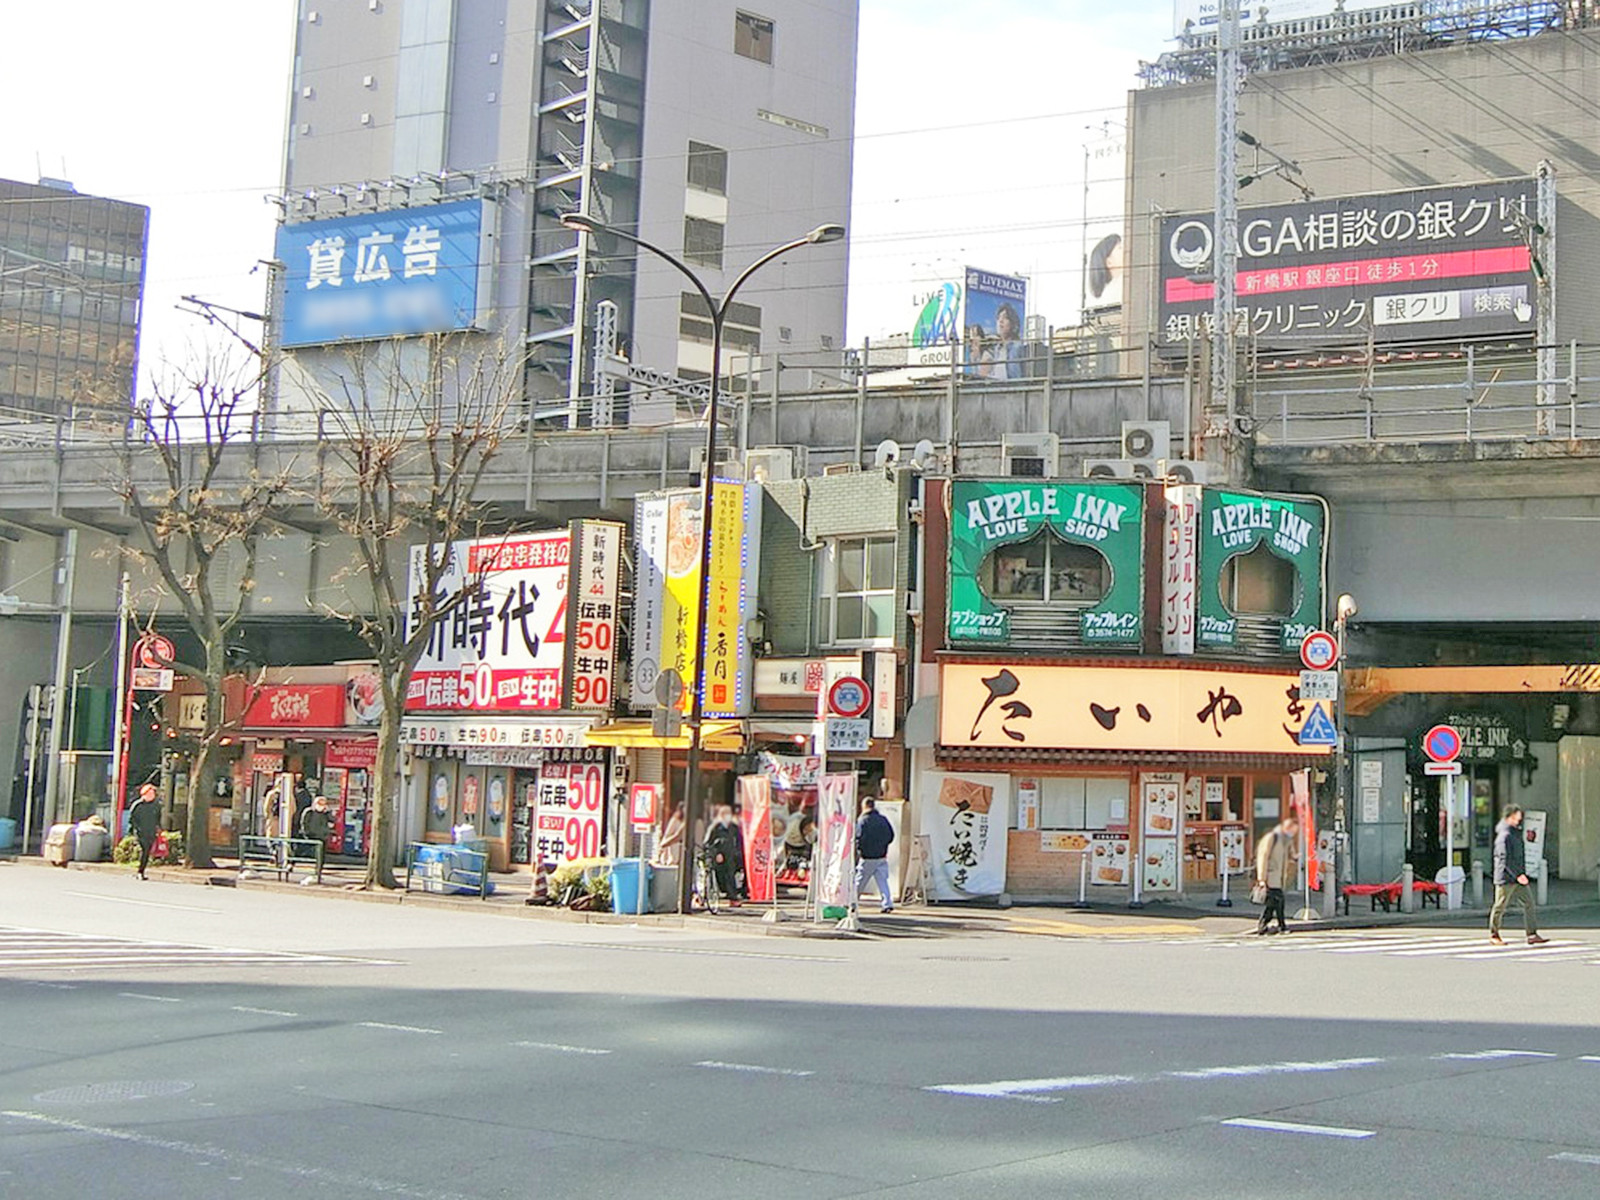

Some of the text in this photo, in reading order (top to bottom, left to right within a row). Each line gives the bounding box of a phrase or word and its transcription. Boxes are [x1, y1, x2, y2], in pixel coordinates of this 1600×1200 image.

[306, 225, 441, 290] 貸広告
[1246, 271, 1299, 291] 新橋駅
[1306, 266, 1359, 286] 銀座口
[1386, 293, 1512, 320] 銀クリ 検索
[920, 351, 953, 364] GROU
[967, 488, 1127, 531] APPLE INN
[984, 518, 1108, 541] LOVE SHOP
[1212, 502, 1313, 548] APPLE INN
[1222, 529, 1302, 555] LOVE SHOP
[581, 602, 612, 620] 伝串
[1084, 611, 1138, 628] アップルイン
[578, 621, 611, 650] 50
[578, 657, 609, 674] 生中
[641, 668, 654, 683] 33
[519, 675, 557, 706] 生中
[574, 676, 609, 704] 90
[970, 668, 1305, 746] たいやき
[832, 721, 865, 731] タクシー
[540, 784, 567, 807] 伝串
[568, 765, 600, 811] 50
[566, 817, 599, 861] 90
[945, 800, 977, 891] たい焼き
